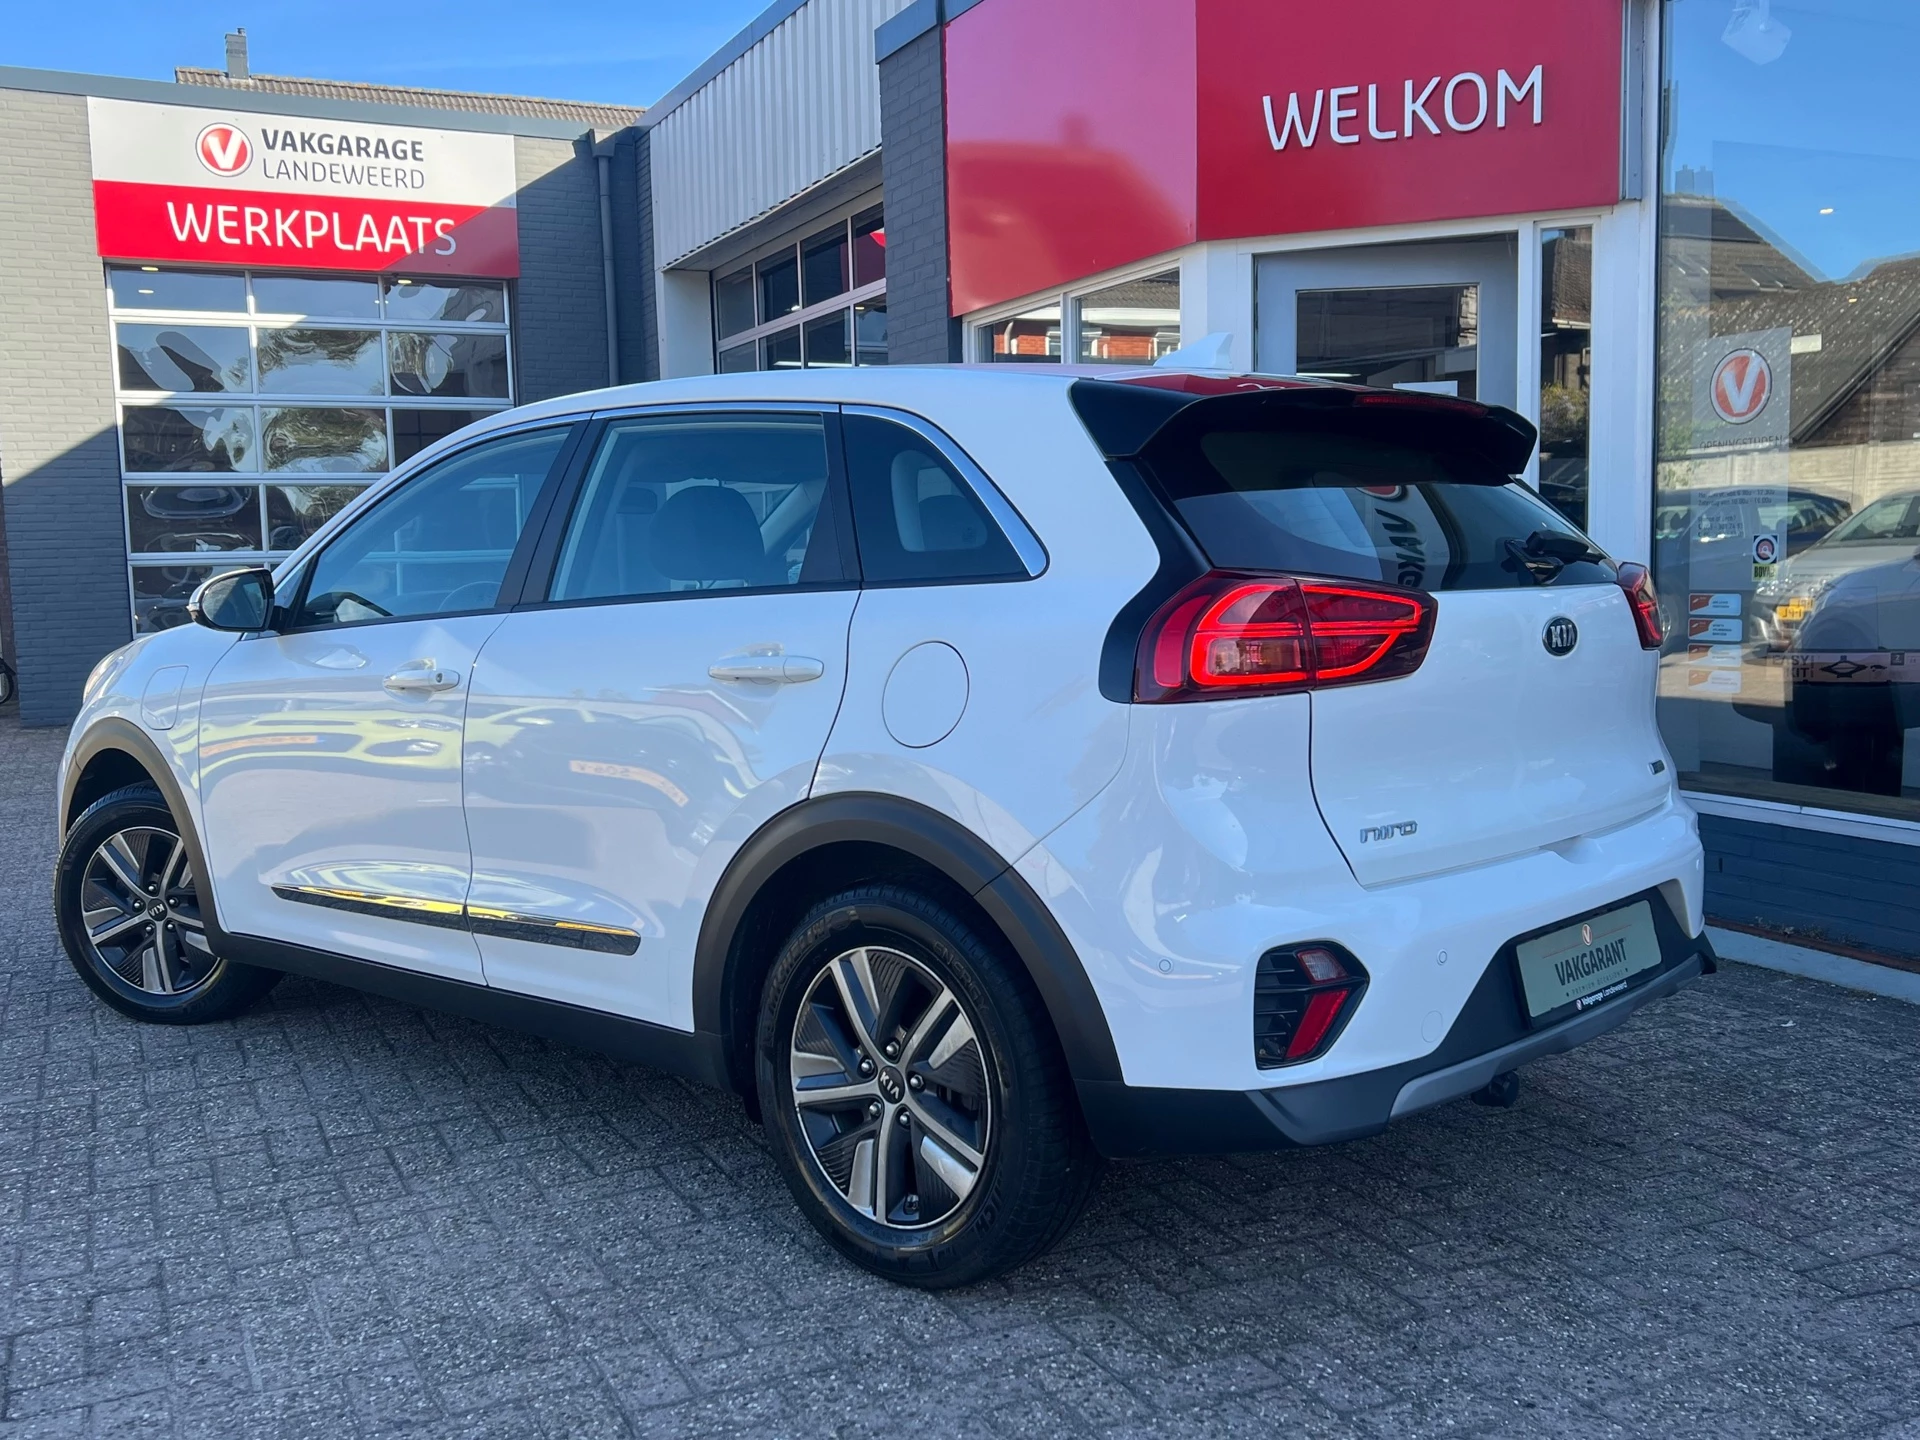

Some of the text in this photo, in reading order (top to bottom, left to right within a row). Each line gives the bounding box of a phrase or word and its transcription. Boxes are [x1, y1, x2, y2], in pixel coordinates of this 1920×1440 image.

[1262, 64, 1543, 151] WELKOM
[261, 128, 425, 162] VAKGARAGE
[263, 159, 426, 190] LANDEWEERD
[166, 201, 457, 257] WERKPLAATS
[1550, 624, 1575, 648] KIA
[1554, 938, 1627, 986] VAKGARANT
[880, 1071, 900, 1100] KIA
